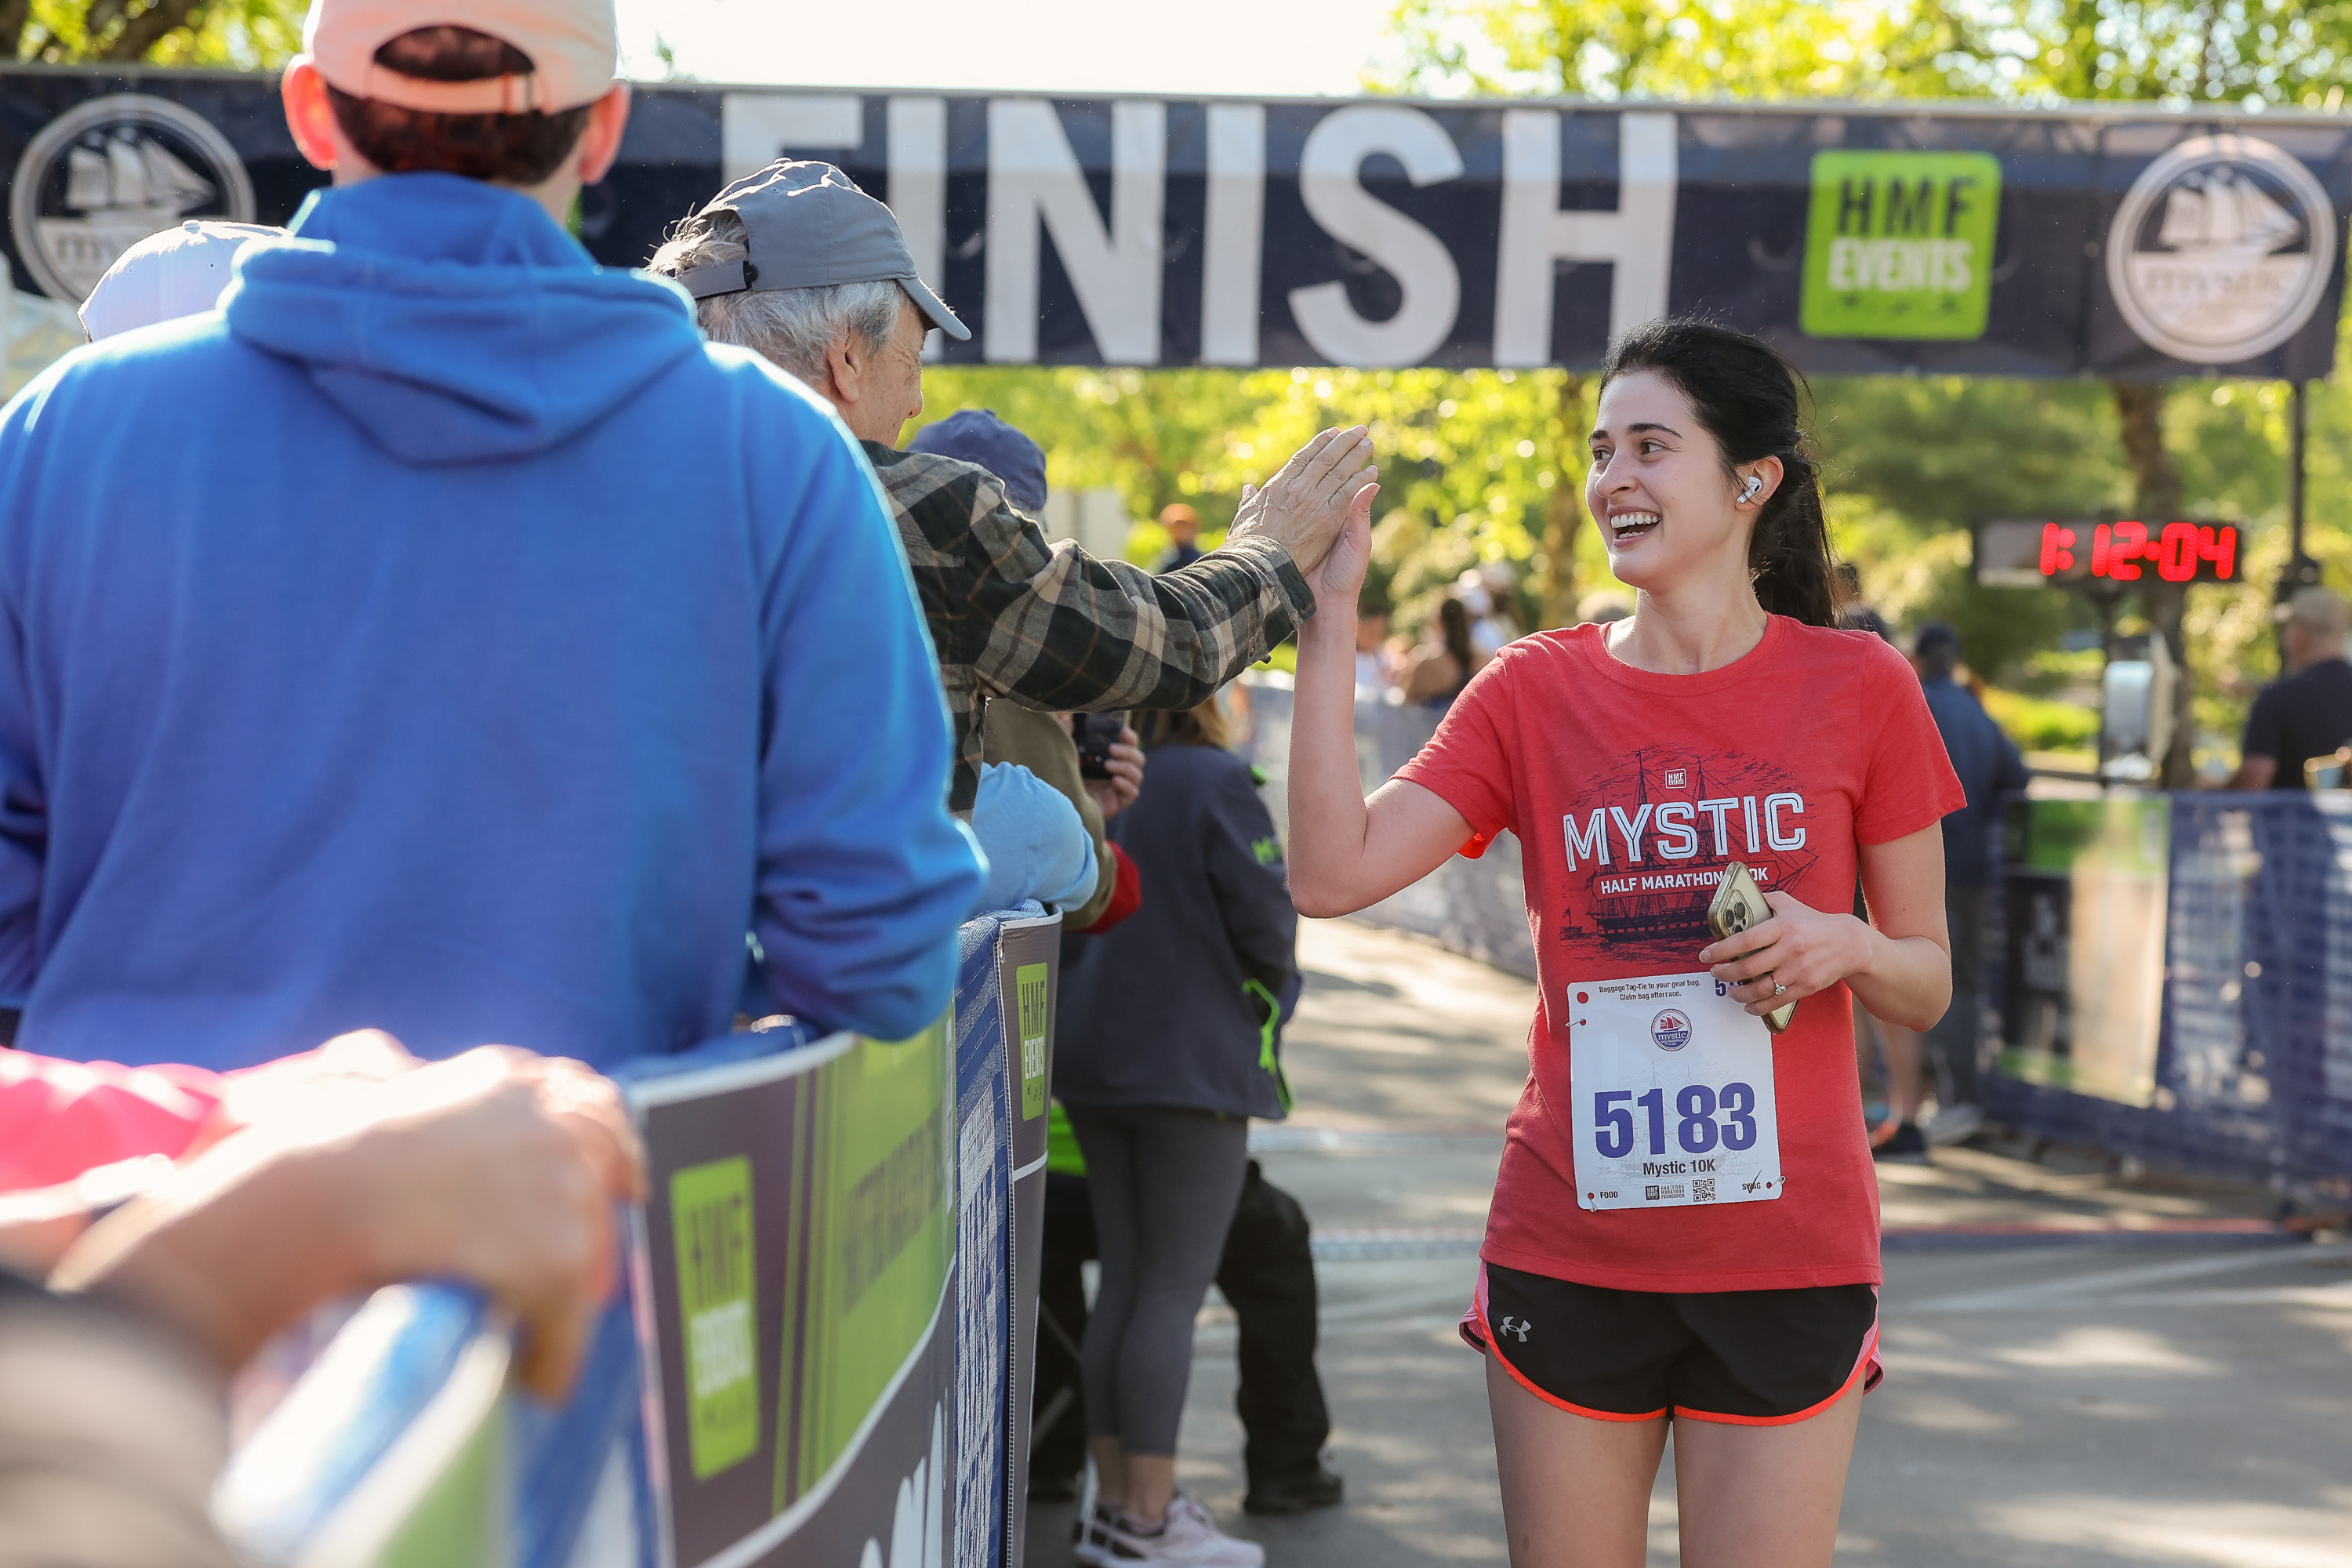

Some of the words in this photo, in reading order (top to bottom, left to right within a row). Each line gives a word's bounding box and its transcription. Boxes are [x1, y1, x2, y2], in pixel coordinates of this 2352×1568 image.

[1838, 173, 1979, 235] HMF
[1828, 237, 1974, 292] EVENTS
[1668, 772, 1683, 781] HMF
[1563, 793, 1806, 873] MYSTIC
[1600, 877, 1638, 895] HALF
[1641, 870, 1724, 890] MARATHON
[1599, 985, 1626, 993] Baggage
[1625, 982, 1647, 992] Tag-Tie
[1656, 982, 1671, 991] your
[1671, 981, 1686, 990] gear
[1686, 979, 1701, 989] bag.
[1638, 993, 1650, 1001] bag
[1022, 980, 1045, 1036] HMF
[1657, 1032, 1686, 1045] mystic
[1024, 1036, 1044, 1080] EVENTS
[1594, 1082, 1757, 1159] 5183
[1642, 1160, 1686, 1178] Mystic
[1690, 1159, 1716, 1173] 10K
[1742, 1181, 1761, 1191] SWAG
